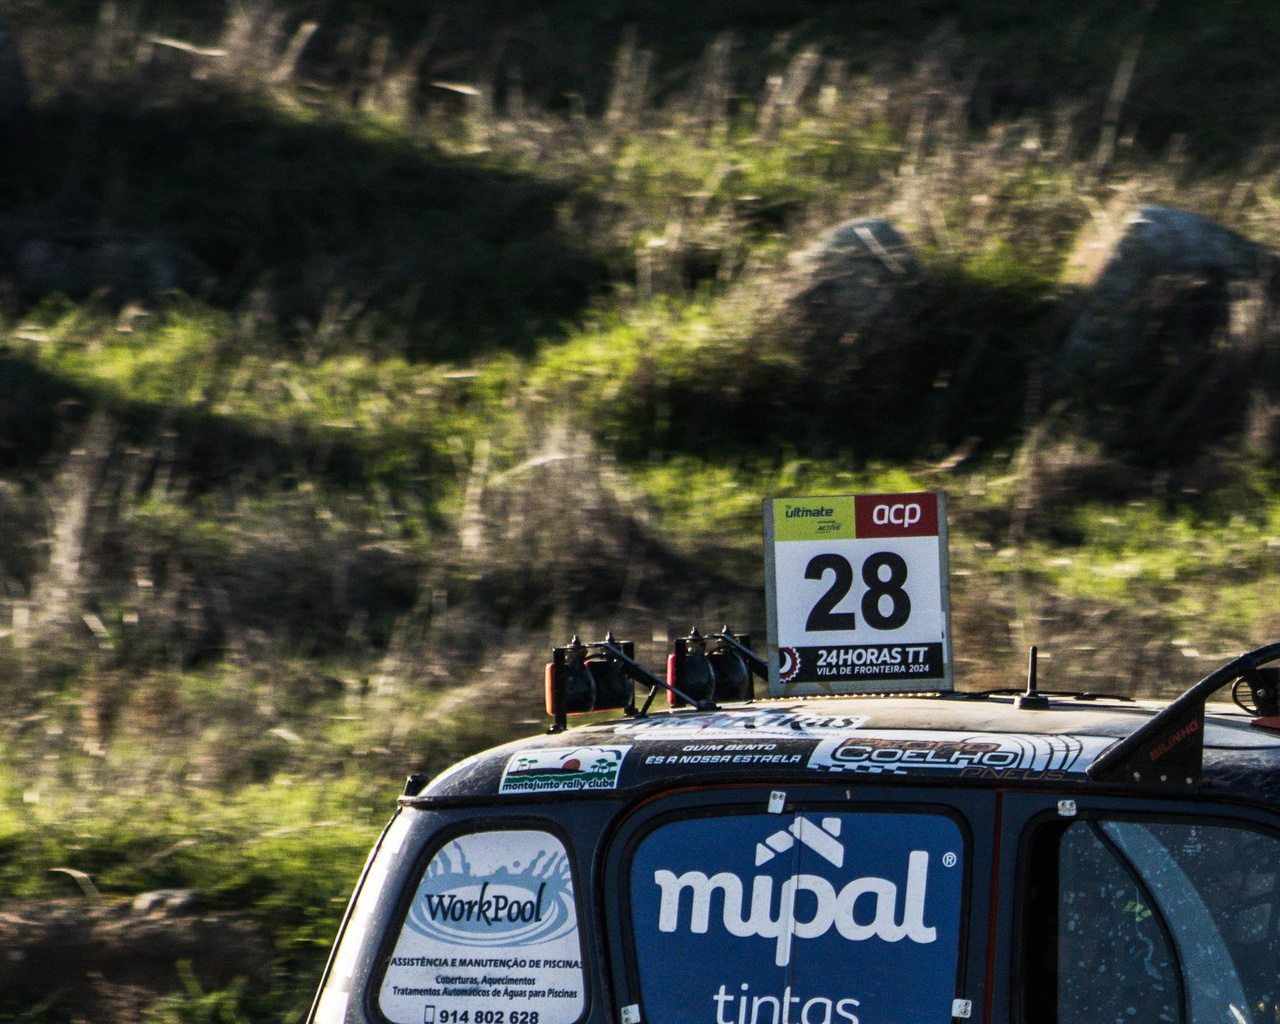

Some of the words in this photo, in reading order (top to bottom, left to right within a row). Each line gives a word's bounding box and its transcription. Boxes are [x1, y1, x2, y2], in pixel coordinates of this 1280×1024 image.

[785, 506, 834, 518] ultimate
[872, 503, 921, 528] acp
[817, 523, 843, 532] ACTIVE
[804, 551, 912, 632] 28
[816, 648, 902, 666] 24HORAS
[905, 647, 928, 663] TT
[816, 667, 837, 675] VILA
[854, 665, 906, 674] FRONTEIRA
[908, 664, 930, 673] 2024
[724, 743, 777, 751] BENTO
[668, 756, 676, 764] A
[679, 755, 731, 764] NOSSA
[733, 755, 802, 764] ESTRELA
[834, 746, 1016, 765] COELHO
[959, 766, 1066, 780] PNEUS
[502, 781, 560, 791] montejunto
[562, 779, 585, 791] rally
[588, 779, 615, 789] clube
[425, 881, 546, 926] WorkPool
[654, 849, 937, 967] mipal
[390, 956, 449, 968] ASSISTÊNCIA
[451, 959, 457, 967] E
[459, 956, 526, 970] MANUTENÇÃO
[529, 960, 541, 968] DE
[481, 974, 536, 986] Aquecimentos
[393, 986, 440, 997] Tratamentos
[442, 986, 490, 997] Automáticos
[492, 988, 501, 997] de
[503, 985, 527, 999] Águas
[528, 990, 545, 1000] para
[547, 988, 577, 998] Piscinas
[439, 1010, 469, 1024] 914
[474, 1011, 504, 1024] 802
[509, 1011, 539, 1024] 628
